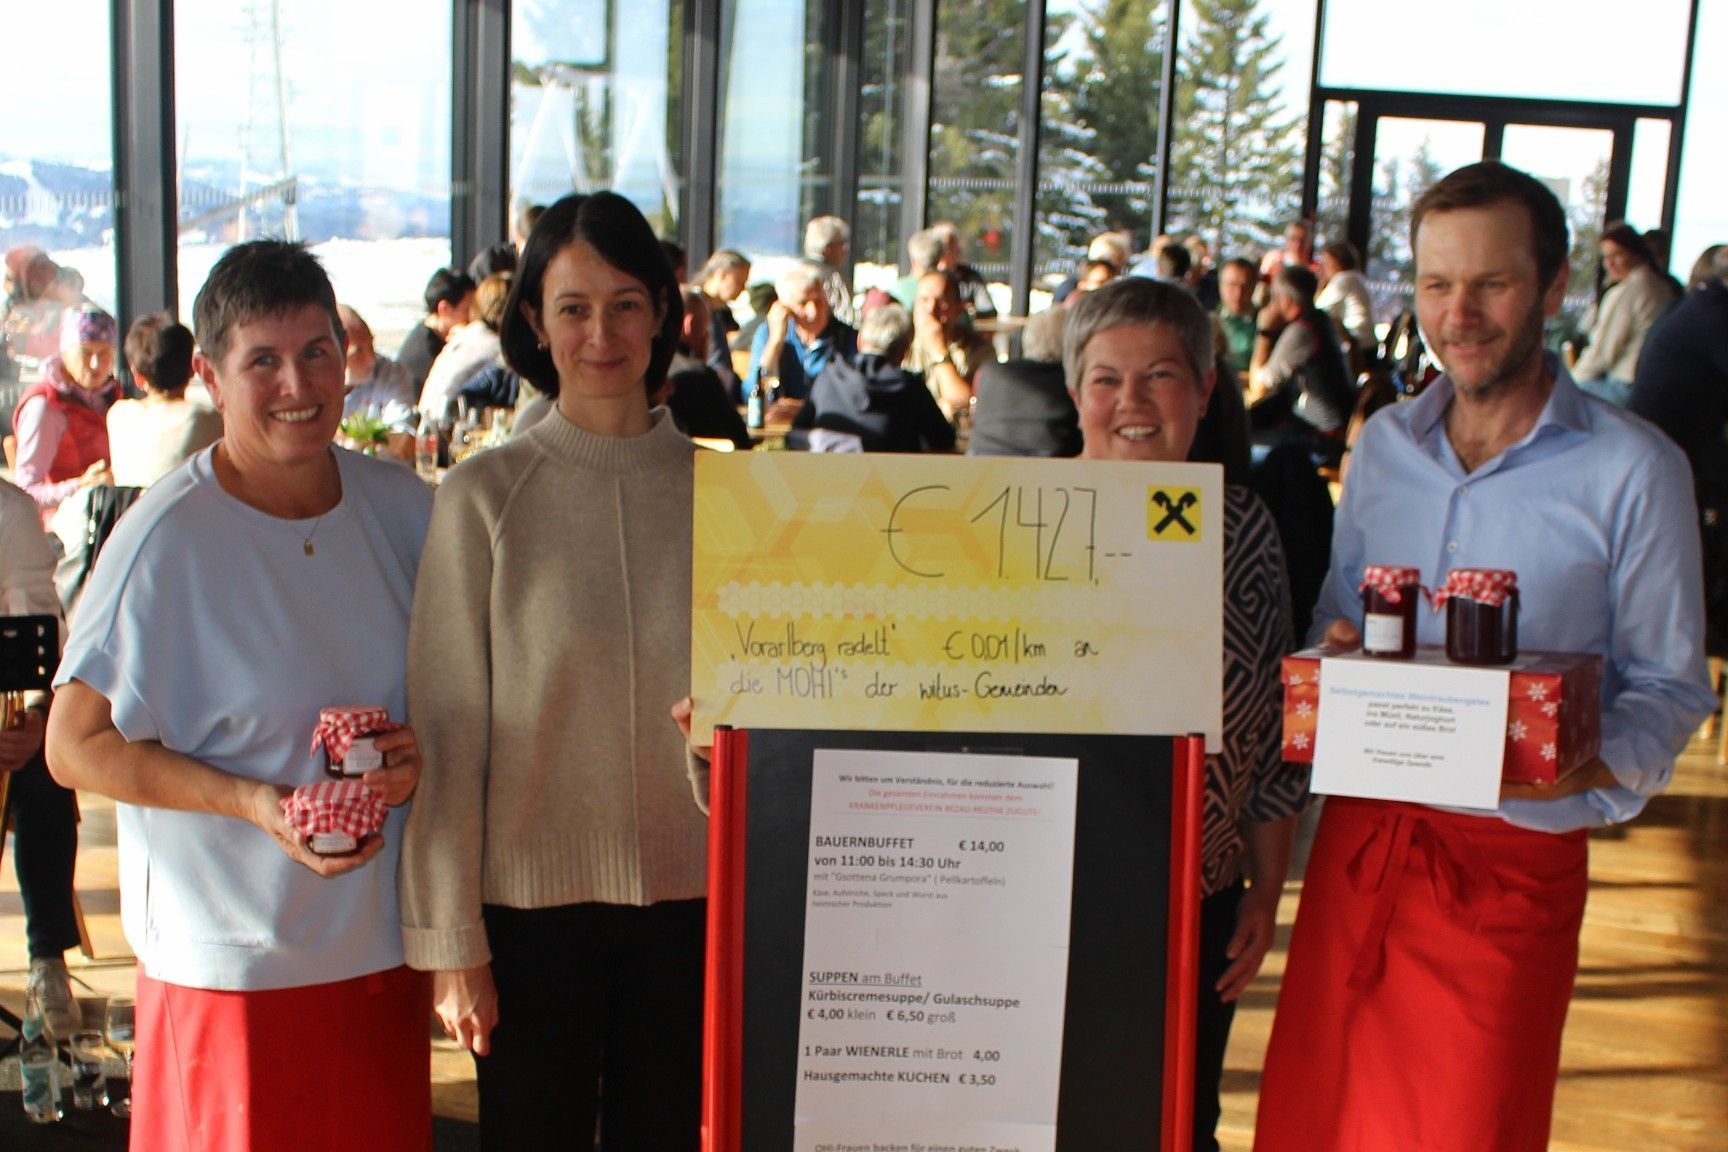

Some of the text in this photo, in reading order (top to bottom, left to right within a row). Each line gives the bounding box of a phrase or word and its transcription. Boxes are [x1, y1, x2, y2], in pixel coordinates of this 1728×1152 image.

[880, 485, 950, 578] €
[942, 630, 965, 660] €
[1074, 640, 1100, 657] an
[730, 669, 764, 695] die
[865, 671, 898, 699] der
[839, 774, 853, 783] Wir
[854, 774, 879, 783] bitten
[880, 776, 894, 784] um
[895, 776, 945, 786] Verständnis,
[946, 778, 959, 786] für
[974, 779, 1015, 789] reduzierte
[868, 787, 881, 797] Die
[815, 835, 1005, 854] BAUERNBUFFET € 14,00
[814, 855, 962, 869] von 11:00 bis 14:30 Uhr
[813, 871, 830, 882] mit
[895, 890, 910, 899] und
[812, 900, 892, 910] heimischer Produktion
[809, 971, 922, 986] SUPPEN am Buffet
[808, 989, 1021, 1010] Kürbiscremesuppe/ Gulaschsuppe
[807, 1007, 956, 1025] € 4,00 klein € 6,50 groß
[804, 1045, 1001, 1063] 1 Paar WIENERLE mit Brot 4,00
[803, 1070, 996, 1087] Hausgemachte KUCHEN € 3,50
